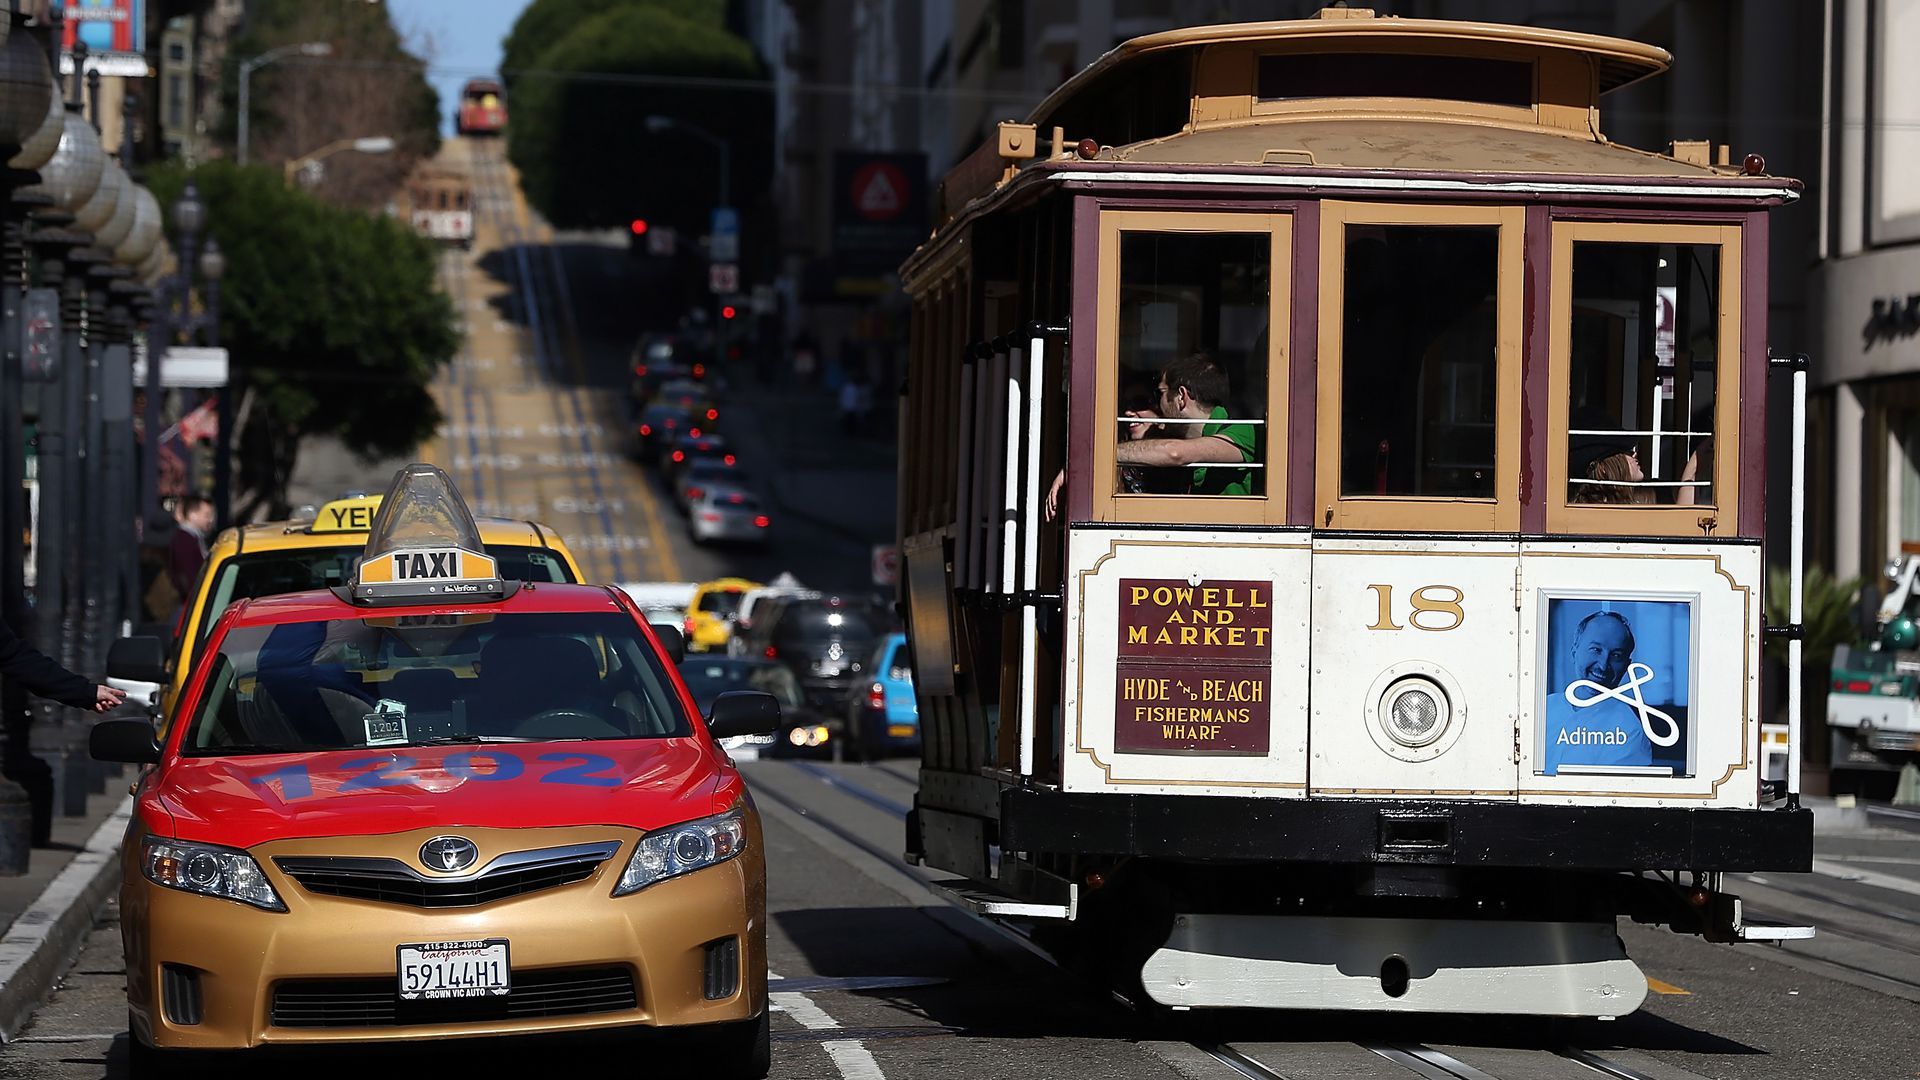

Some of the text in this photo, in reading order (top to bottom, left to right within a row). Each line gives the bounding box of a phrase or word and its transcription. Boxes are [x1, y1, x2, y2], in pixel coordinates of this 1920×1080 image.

[394, 552, 457, 579] TAXI
[1130, 586, 1267, 608] POWELL
[1166, 609, 1234, 625] AND
[1365, 584, 1465, 632] 18
[1127, 625, 1270, 647] MARKET
[1123, 678, 1263, 702] HYDE AND BEACH
[1134, 707, 1250, 723] FISHERMANS
[372, 721, 399, 733] 1202
[1162, 724, 1222, 740] WHARF
[1556, 726, 1628, 745] Adimab
[250, 751, 623, 800] 1202
[424, 941, 483, 950] 415-822-4900
[421, 949, 489, 962] California
[406, 961, 503, 990] 59144H1
[425, 988, 486, 999] CROWN VIC AUTO
